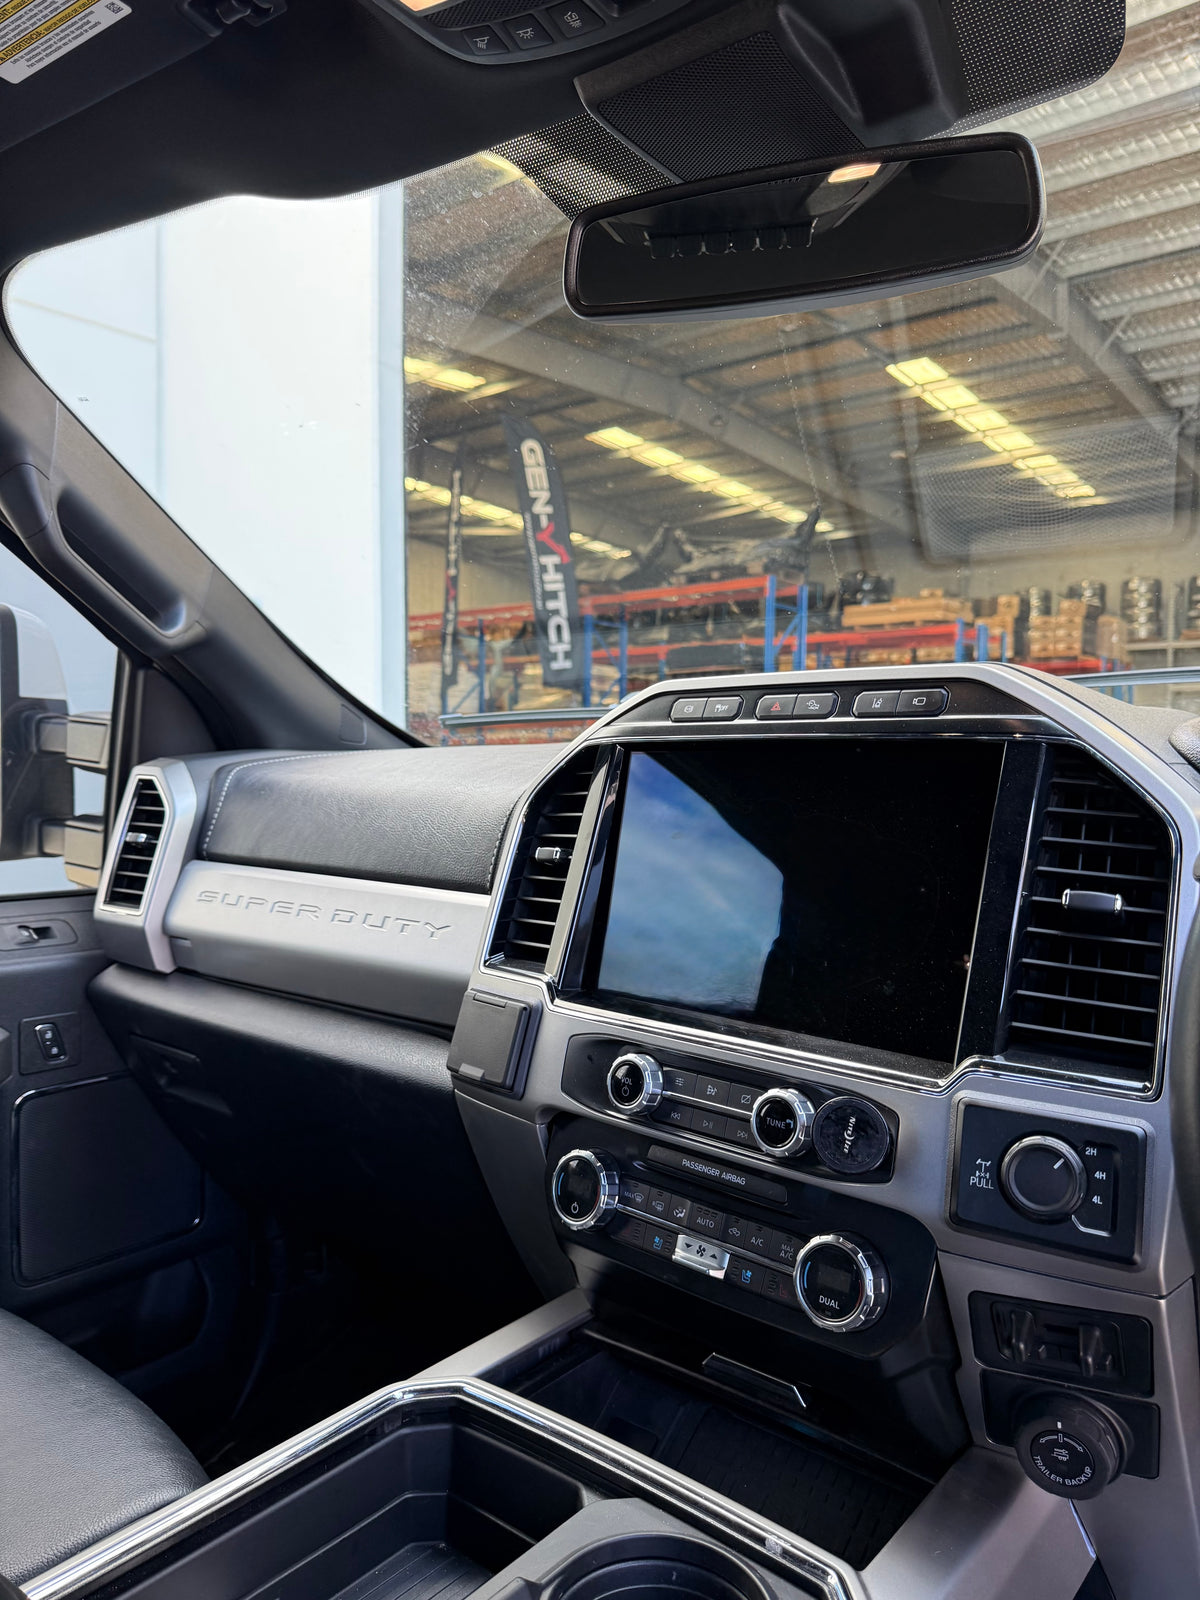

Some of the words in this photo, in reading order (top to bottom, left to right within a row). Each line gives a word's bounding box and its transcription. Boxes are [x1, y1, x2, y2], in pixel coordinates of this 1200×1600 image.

[520, 438, 571, 564] GEN-Y
[539, 554, 573, 671] HITCH
[197, 889, 322, 920] SUPER
[330, 908, 452, 940] DUTY
[620, 1076, 633, 1086] VOL
[766, 1117, 787, 1130] TUNE
[1085, 1147, 1097, 1156] 2H
[682, 1159, 720, 1177] PASSENGER
[721, 1172, 746, 1185] AIRBAG
[1094, 1171, 1106, 1180] 4H
[969, 1176, 994, 1189] PULL
[1092, 1195, 1103, 1205] 4L
[696, 1216, 715, 1229] AUTO
[750, 1236, 764, 1247] A/C
[781, 1244, 794, 1253] MAX
[779, 1250, 793, 1261] A/C
[819, 1295, 840, 1310] DUAL
[1033, 1456, 1063, 1484] TRAILER
[1065, 1466, 1092, 1486] BACKUP
